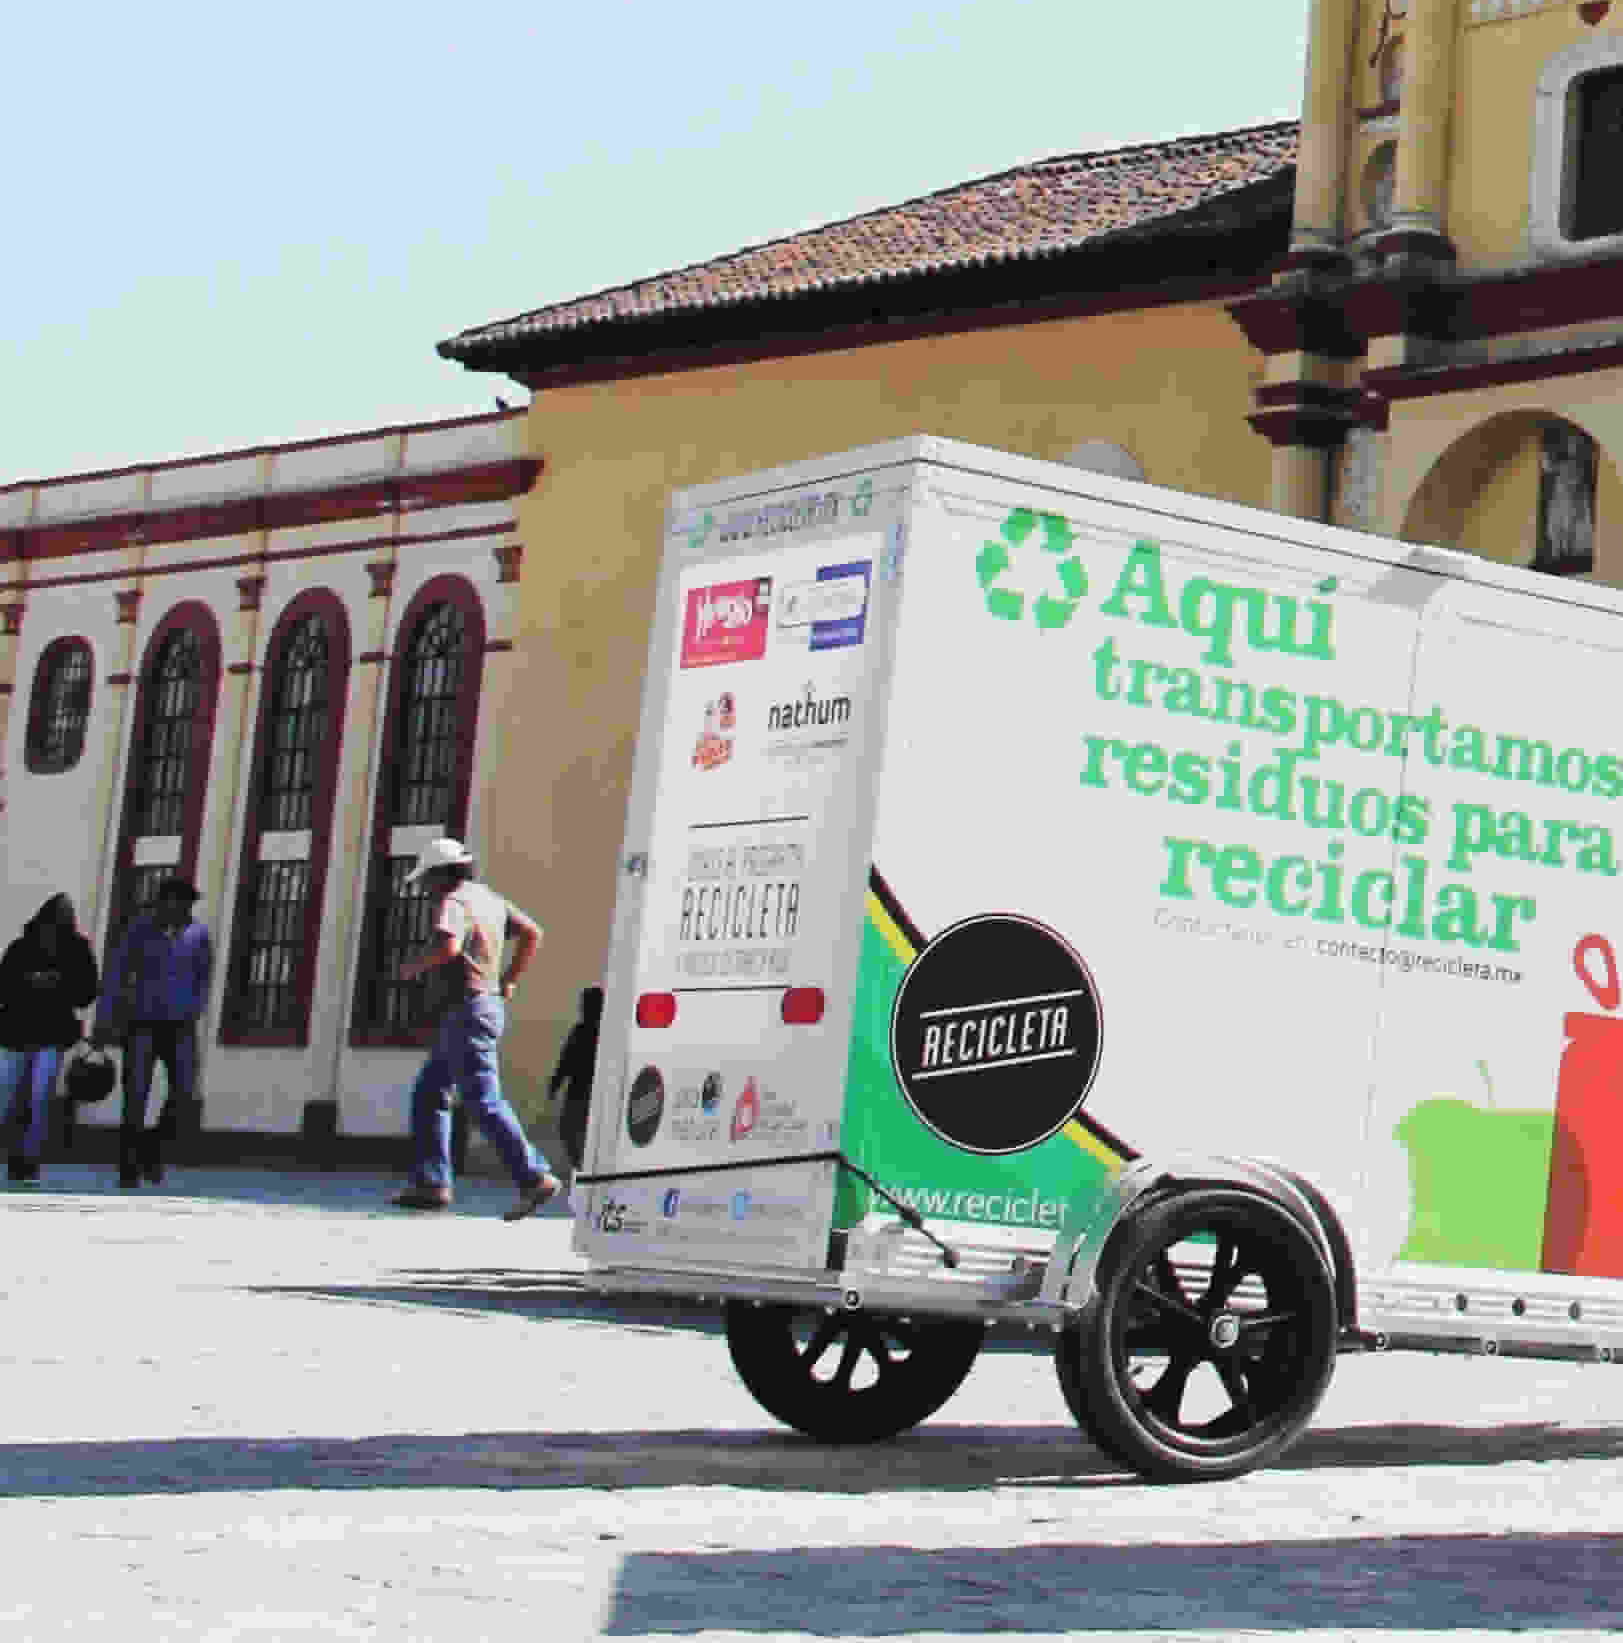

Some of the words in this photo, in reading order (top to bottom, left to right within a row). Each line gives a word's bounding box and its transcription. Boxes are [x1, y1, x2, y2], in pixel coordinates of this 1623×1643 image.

[1100, 538, 1338, 669] Aquí
[768, 691, 851, 730] nathum
[1078, 730, 1430, 848] residuos
[1447, 796, 1623, 877] para
[679, 883, 800, 941] RECICLETA
[1158, 834, 1538, 955] reciclar
[920, 1005, 1069, 1069] RECICLETA
